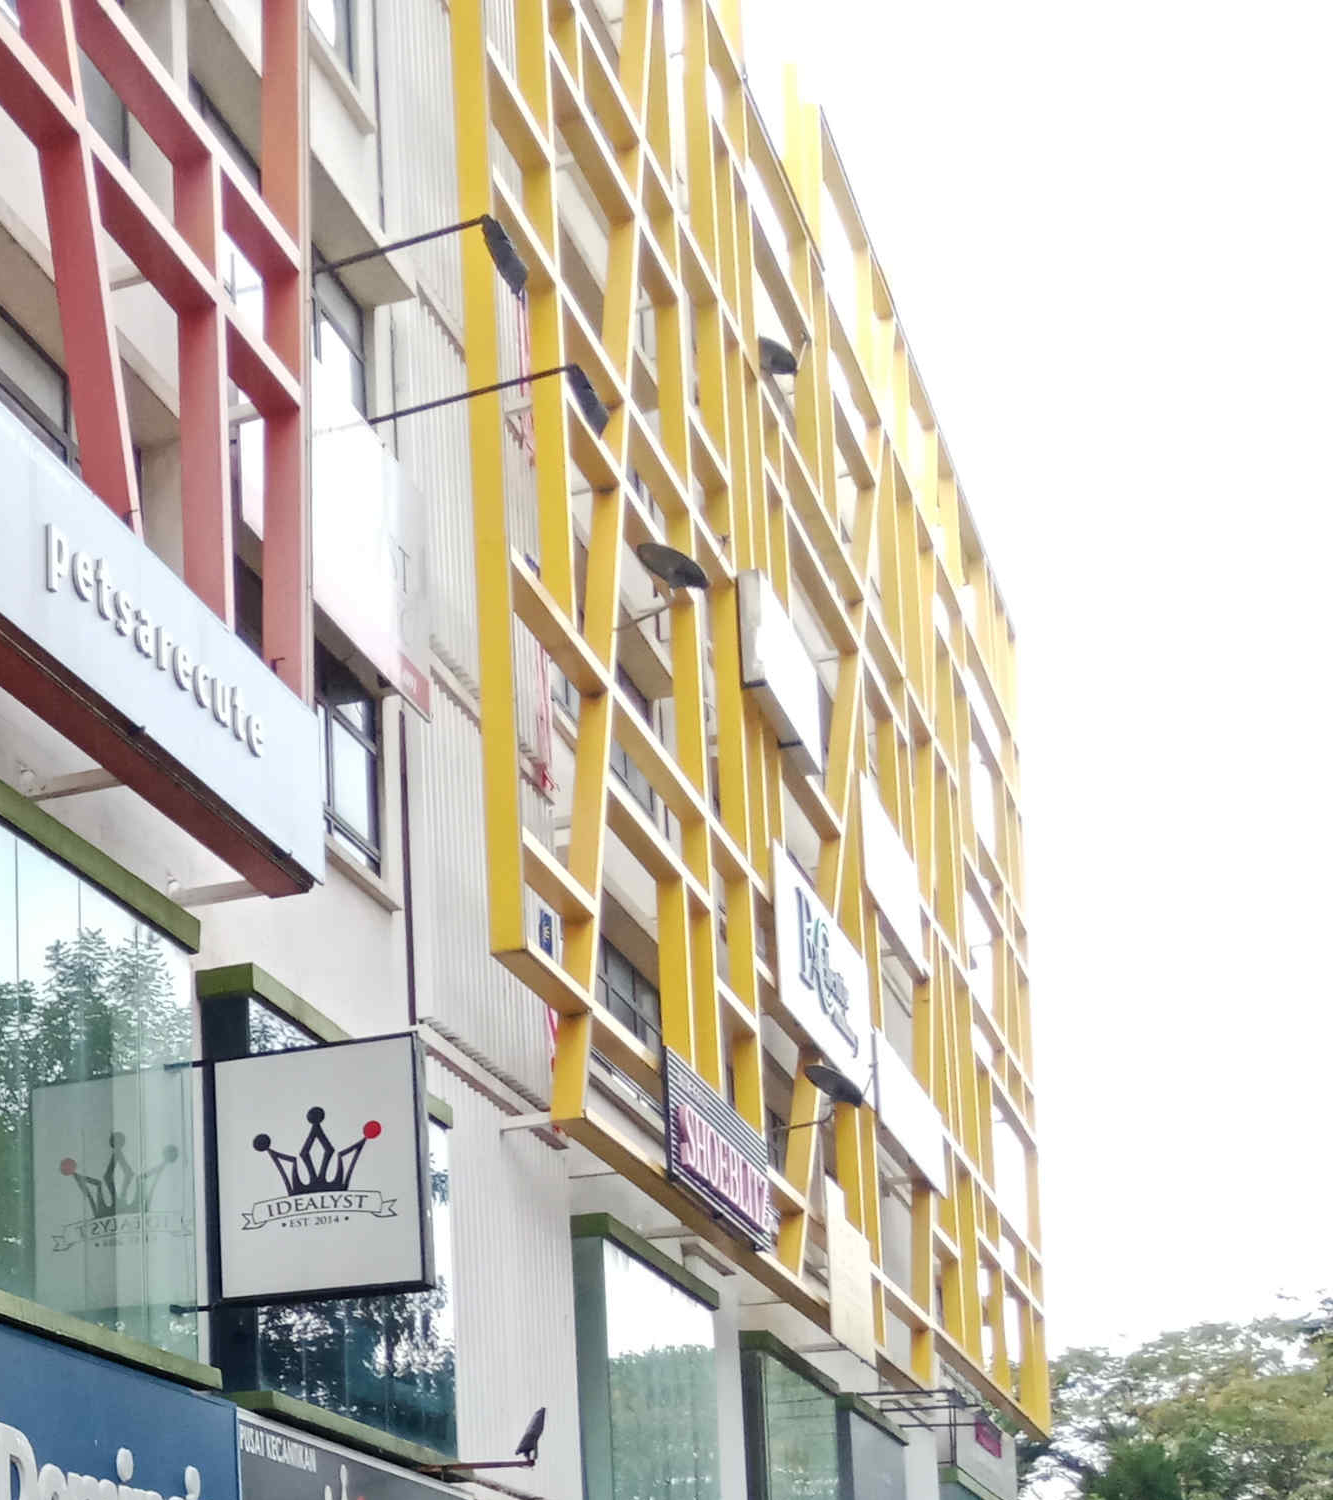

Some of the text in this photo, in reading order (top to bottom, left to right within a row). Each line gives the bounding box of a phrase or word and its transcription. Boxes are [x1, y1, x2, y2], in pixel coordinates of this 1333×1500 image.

[45, 522, 265, 758] petsarecute
[267, 1194, 369, 1217] IDEALYST
[314, 1216, 340, 1227] 2014
